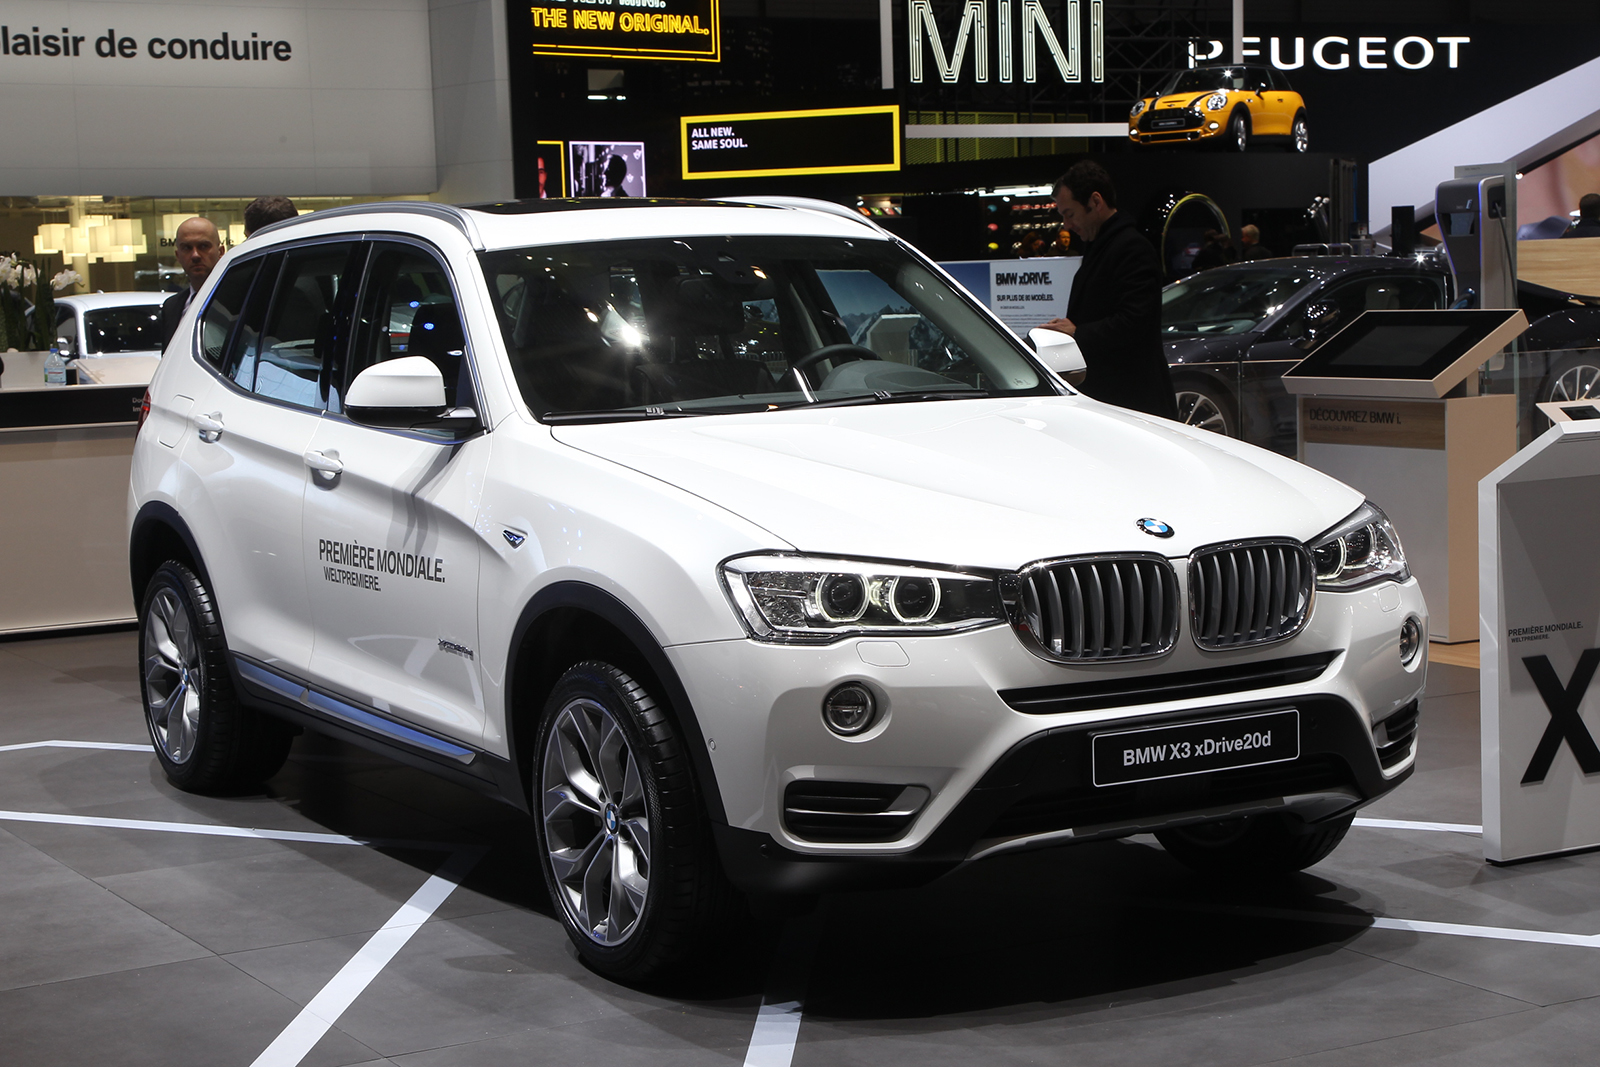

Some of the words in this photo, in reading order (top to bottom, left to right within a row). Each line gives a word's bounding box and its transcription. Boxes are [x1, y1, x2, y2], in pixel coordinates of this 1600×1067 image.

[531, 7, 567, 28] THE
[573, 10, 615, 30] NEW
[619, 12, 709, 35] ORIGINAL.
[1, 26, 85, 57] laisir
[95, 29, 137, 58] de
[148, 32, 292, 61] conduire
[908, 0, 1104, 83] MINI
[691, 128, 710, 138] ALL
[710, 126, 735, 137] NEW.
[691, 139, 718, 150] SAME
[720, 138, 748, 149] SOUL.
[996, 272, 1018, 286] BMW
[1018, 272, 1052, 286] xDRIVE.
[1309, 407, 1367, 423] DÉCOUVREZ
[1370, 411, 1395, 424] BMW
[319, 539, 375, 571] PREMIÈRE
[376, 549, 446, 583] MONDIALE.
[323, 566, 381, 592] WELTPREMIERE.
[1508, 625, 1544, 637] PREMIÈRE
[1545, 621, 1584, 633] MONDIALE.
[1511, 633, 1550, 643] WELTPREMIERE.
[1520, 648, 1600, 785] X
[1123, 745, 1167, 766] BMW
[1169, 742, 1191, 760] X3
[1194, 730, 1272, 757] xDrive20d
